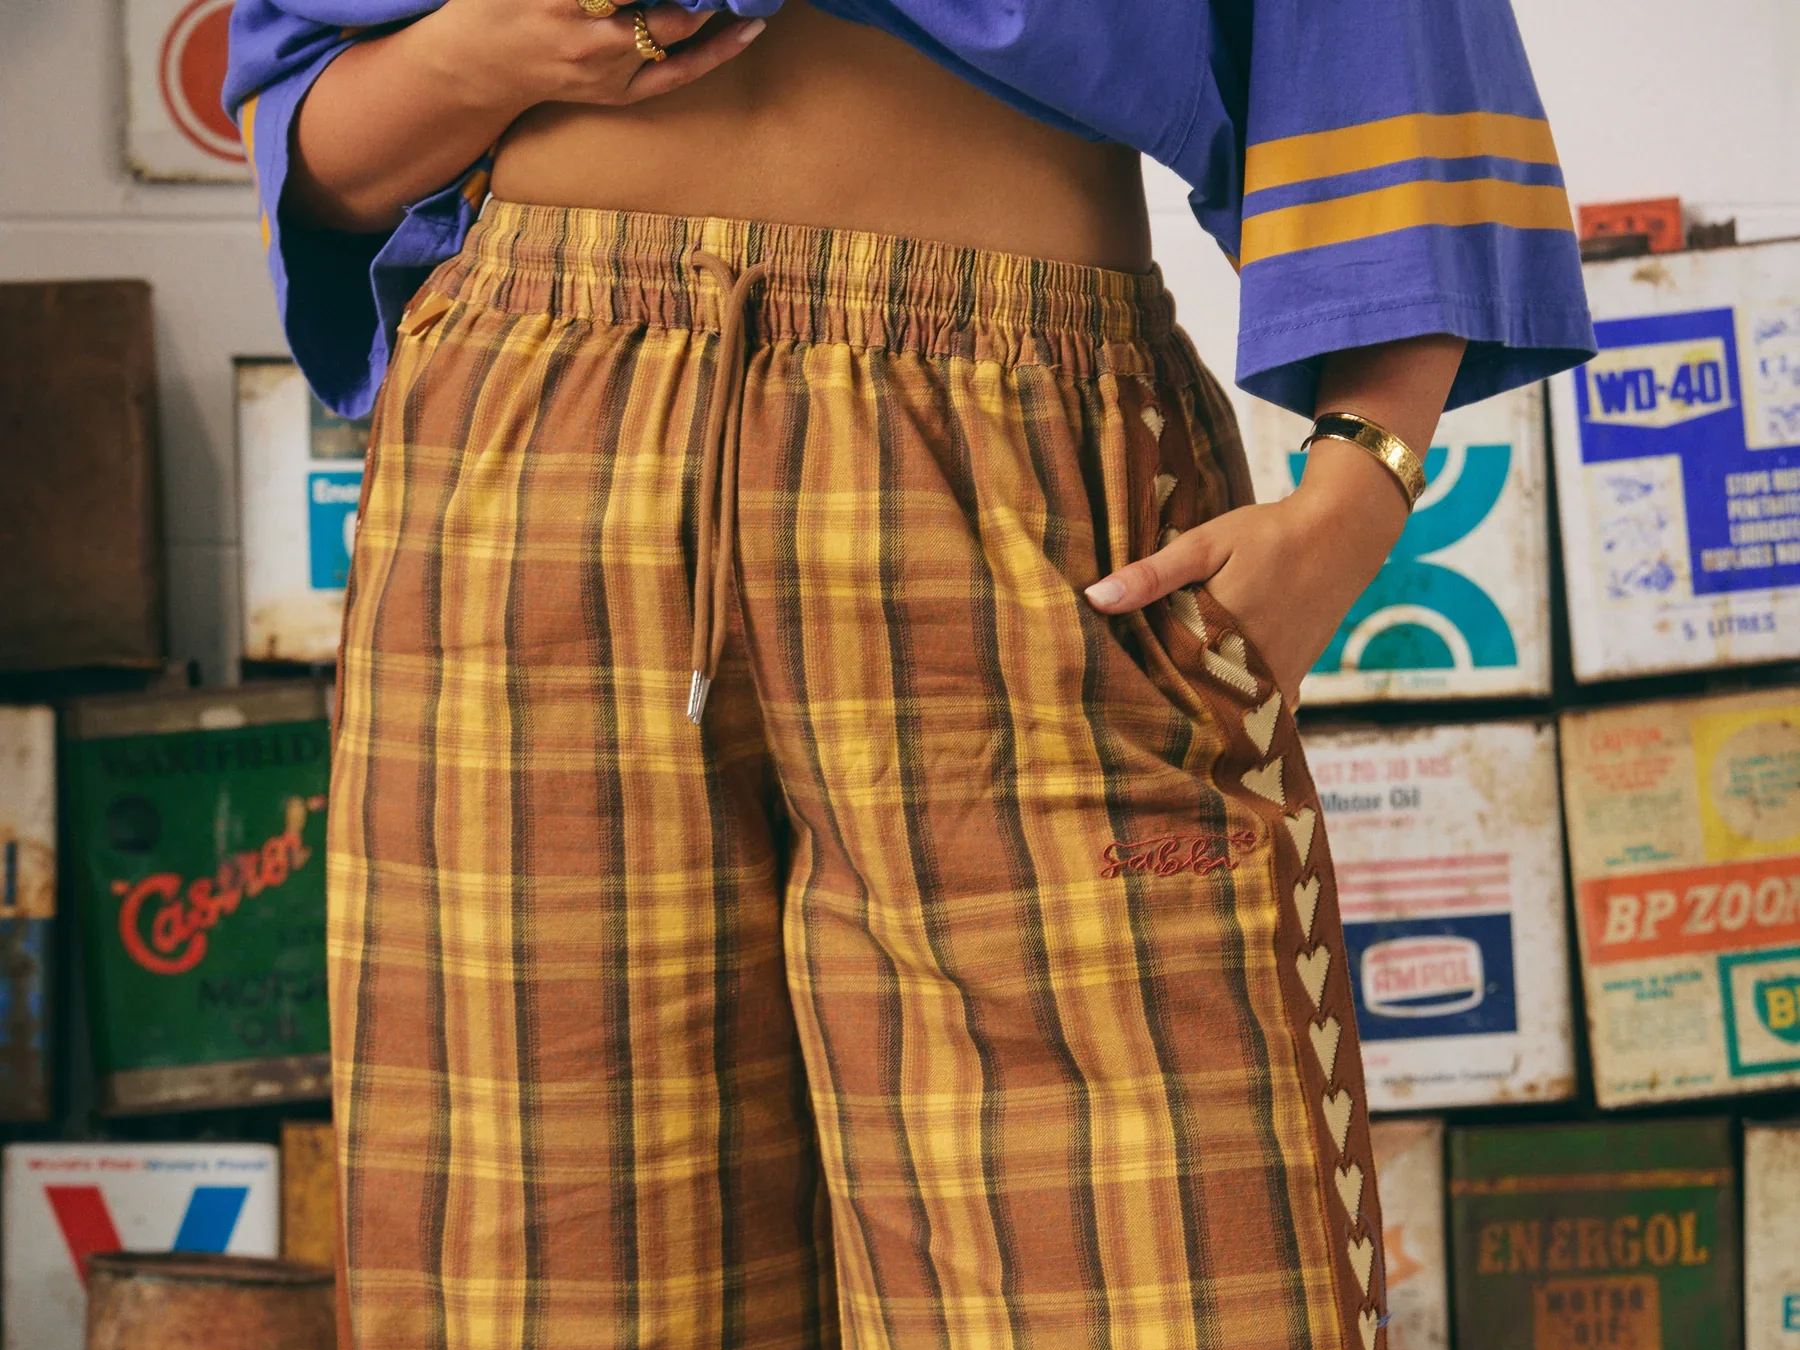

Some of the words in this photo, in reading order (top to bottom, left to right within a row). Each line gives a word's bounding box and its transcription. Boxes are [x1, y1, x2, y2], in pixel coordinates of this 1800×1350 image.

[1595, 361, 1722, 414] WD-40
[1603, 890, 1678, 946] BP
[1477, 1211, 1709, 1275] ENERGOL
